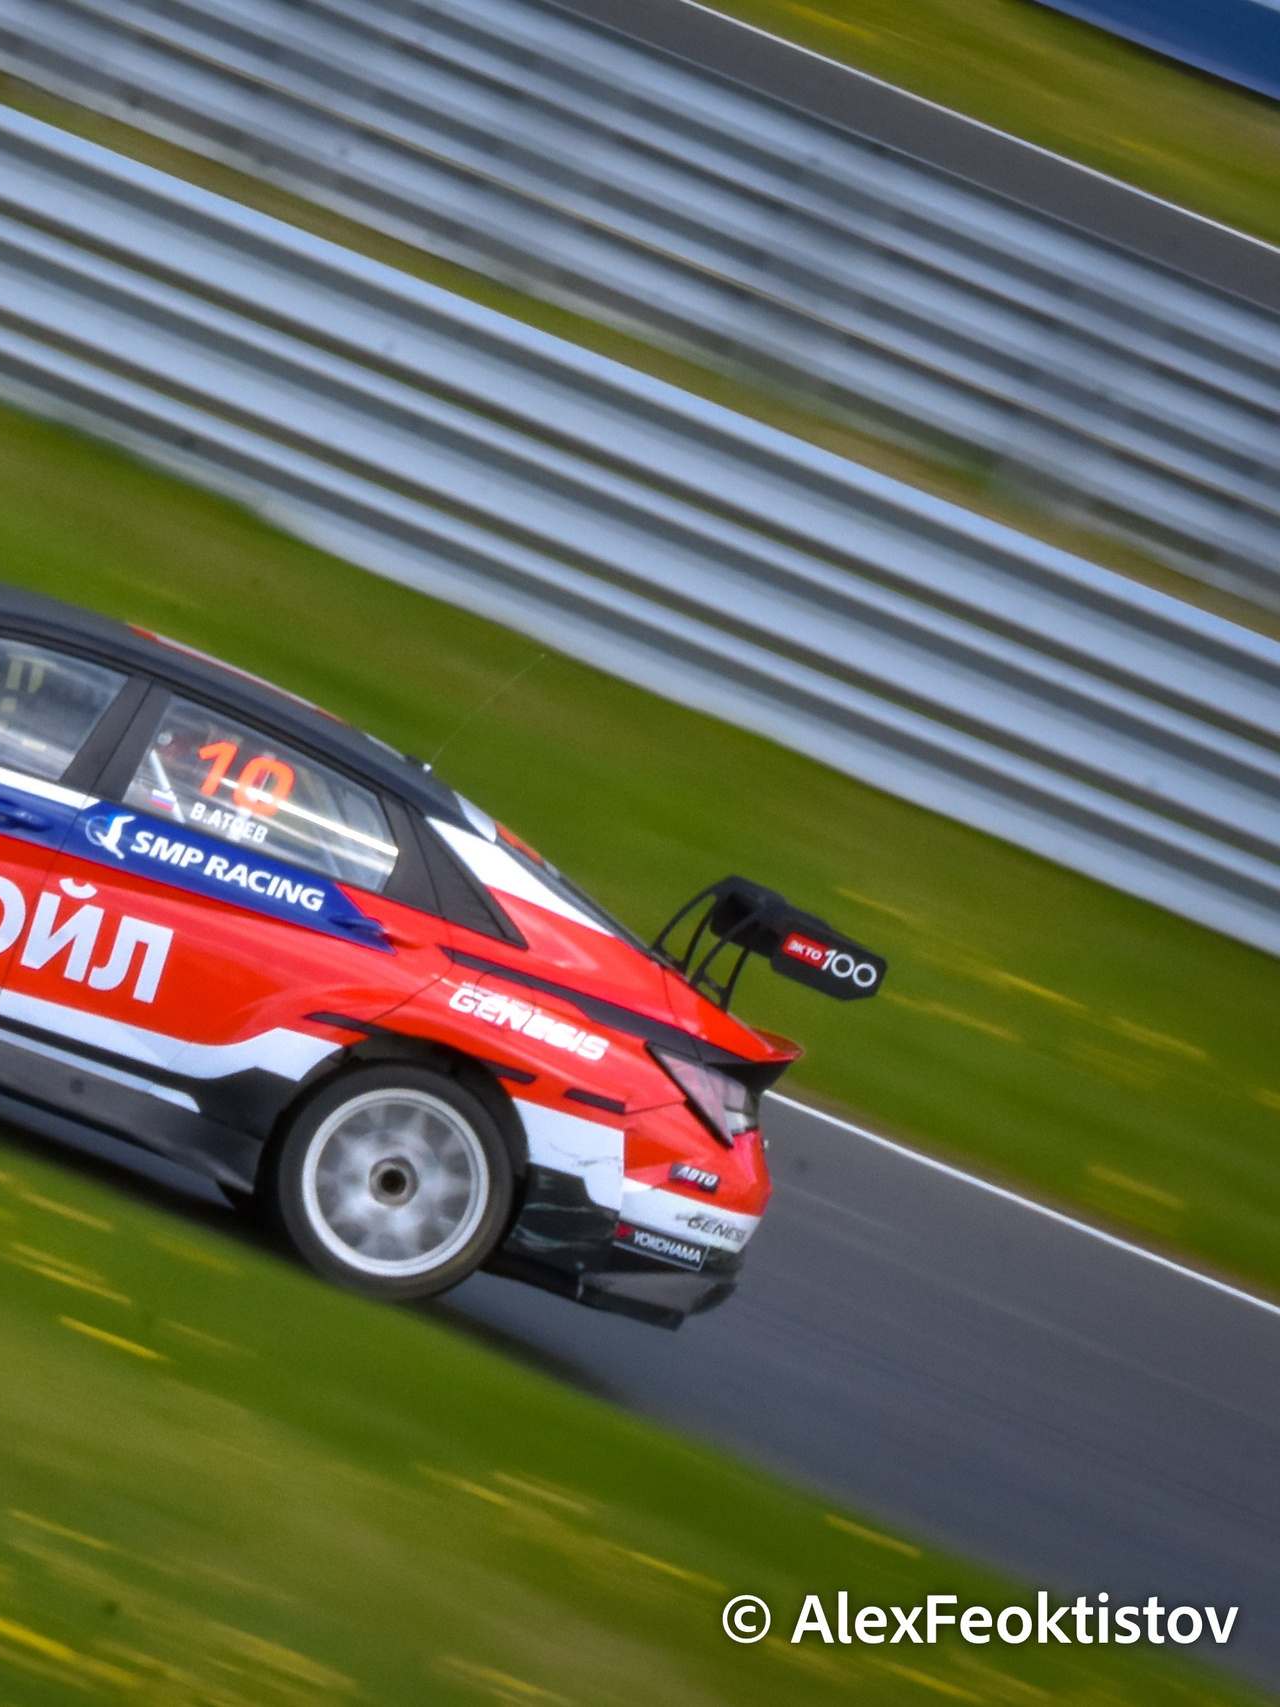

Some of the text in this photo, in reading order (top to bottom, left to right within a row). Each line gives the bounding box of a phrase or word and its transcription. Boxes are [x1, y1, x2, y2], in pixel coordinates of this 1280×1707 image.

[198, 740, 297, 817] 10
[130, 830, 326, 913] SMP RACING
[821, 948, 878, 989] 100
[633, 1230, 701, 1263] YOKOHAMA
